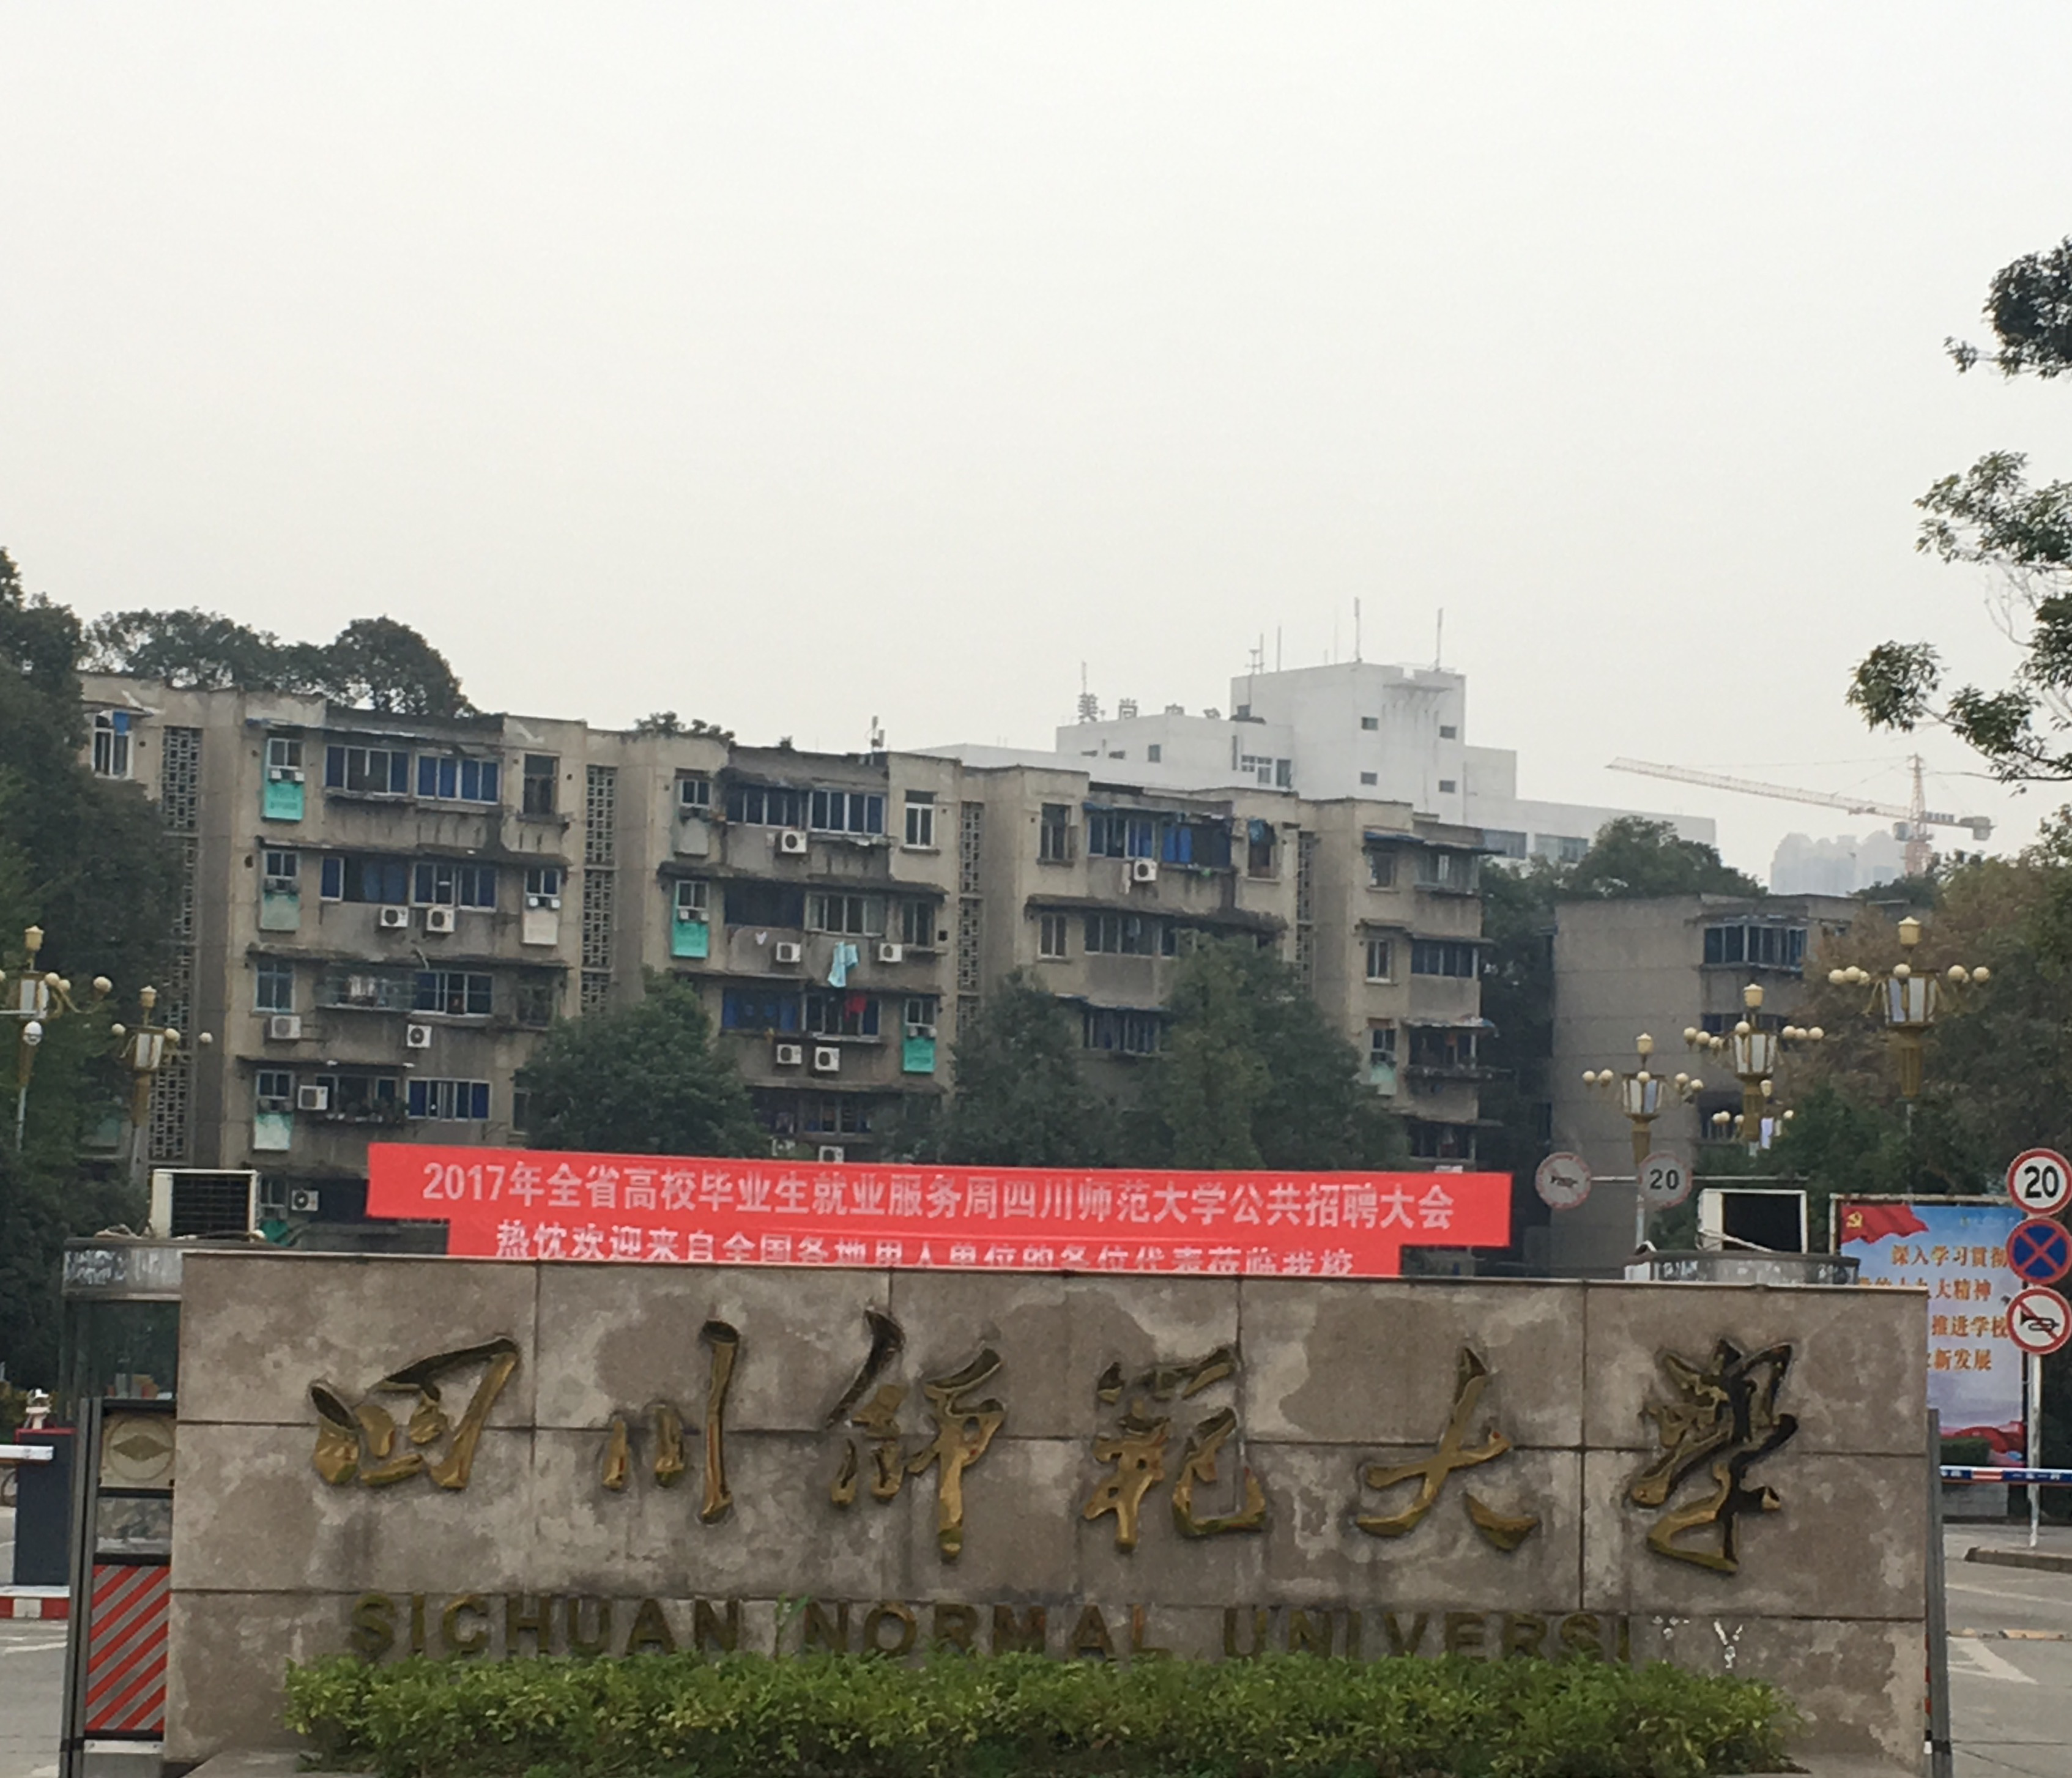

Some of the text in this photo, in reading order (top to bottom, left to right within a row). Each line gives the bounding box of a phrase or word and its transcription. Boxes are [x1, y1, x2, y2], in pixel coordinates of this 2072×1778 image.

[422, 1161, 1455, 1230] 2017年全省高校毕业生就业服务周四川师范大学公共招聘大会
[1650, 1169, 1679, 1191] 20
[2024, 1166, 2060, 1198] 20
[1928, 1347, 1992, 1371] 新发展
[349, 1593, 739, 1661] SICHUAN
[803, 1601, 1175, 1661] NORMAL
